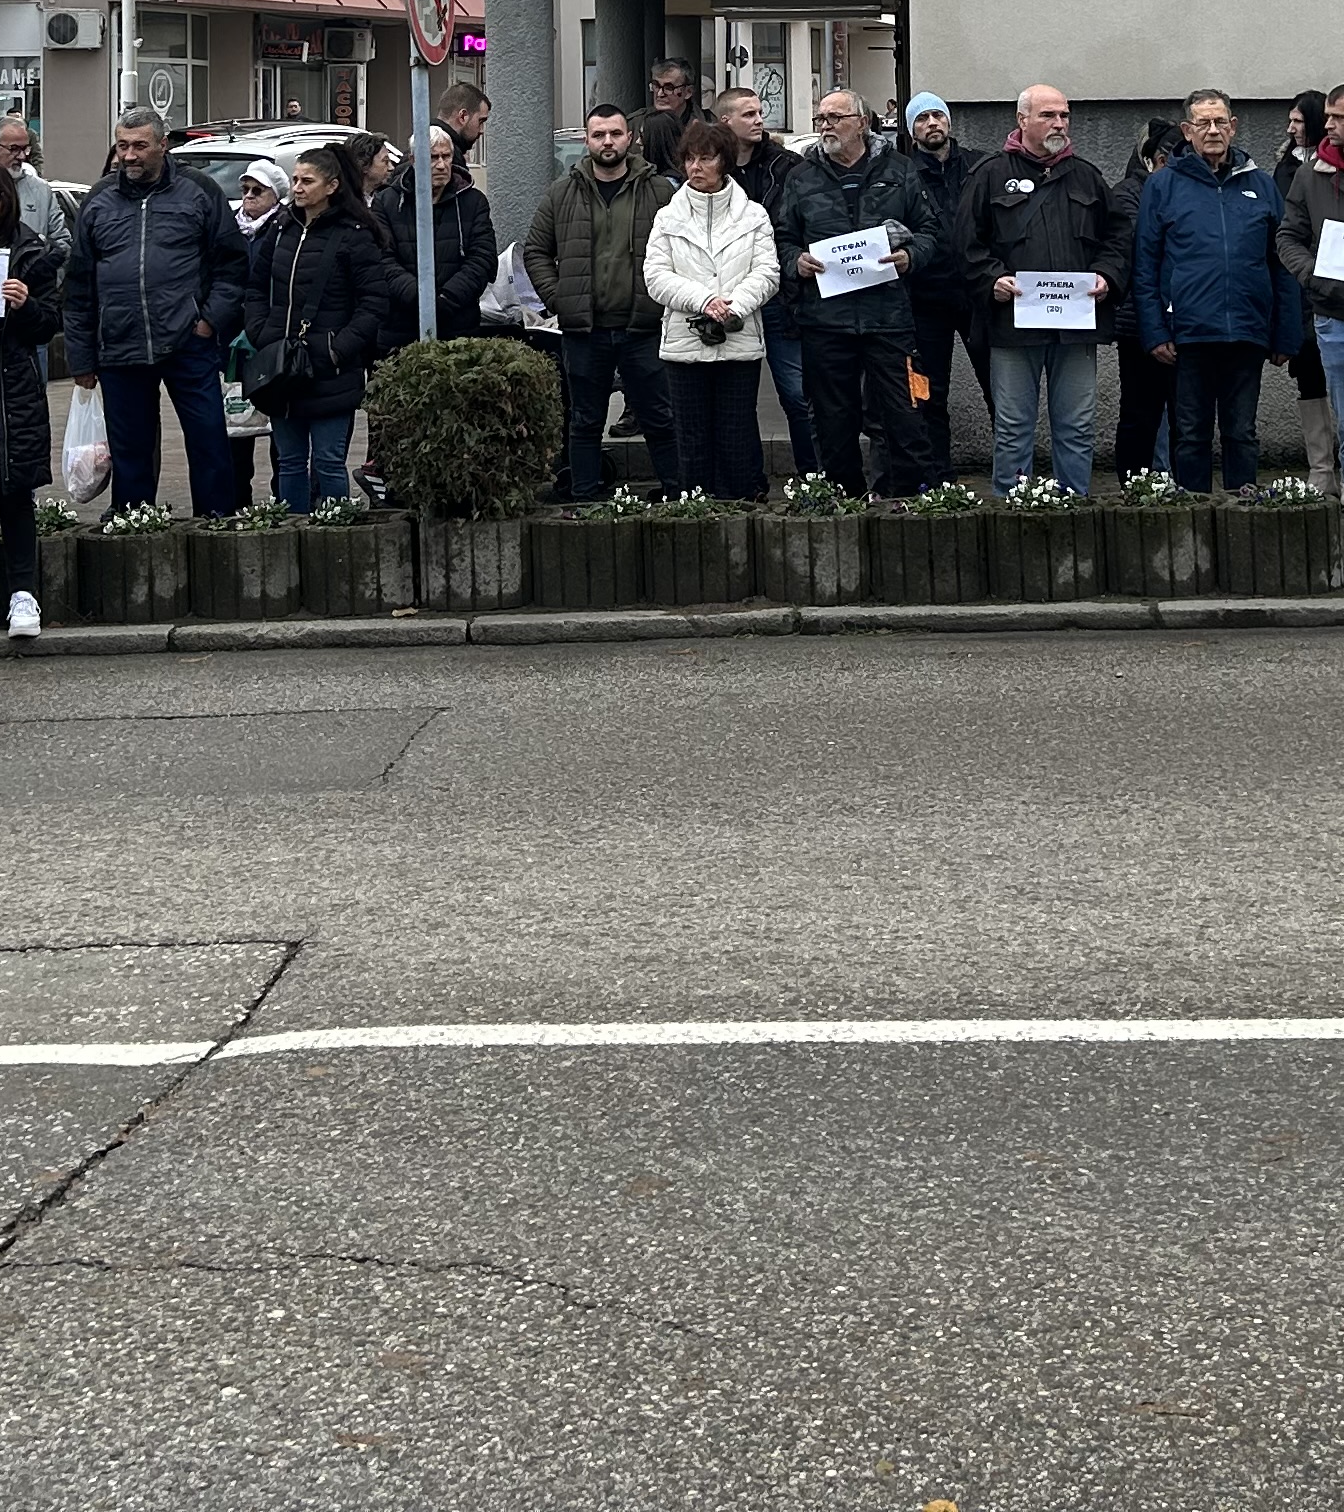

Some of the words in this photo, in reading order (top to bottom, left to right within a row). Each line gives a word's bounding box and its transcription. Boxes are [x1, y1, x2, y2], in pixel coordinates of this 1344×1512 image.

[831, 240, 867, 254] СТЕФАН
[840, 254, 864, 265] ХРКА
[1036, 280, 1074, 289] АНЂЕЛА
[1039, 292, 1070, 300] РУМАН
